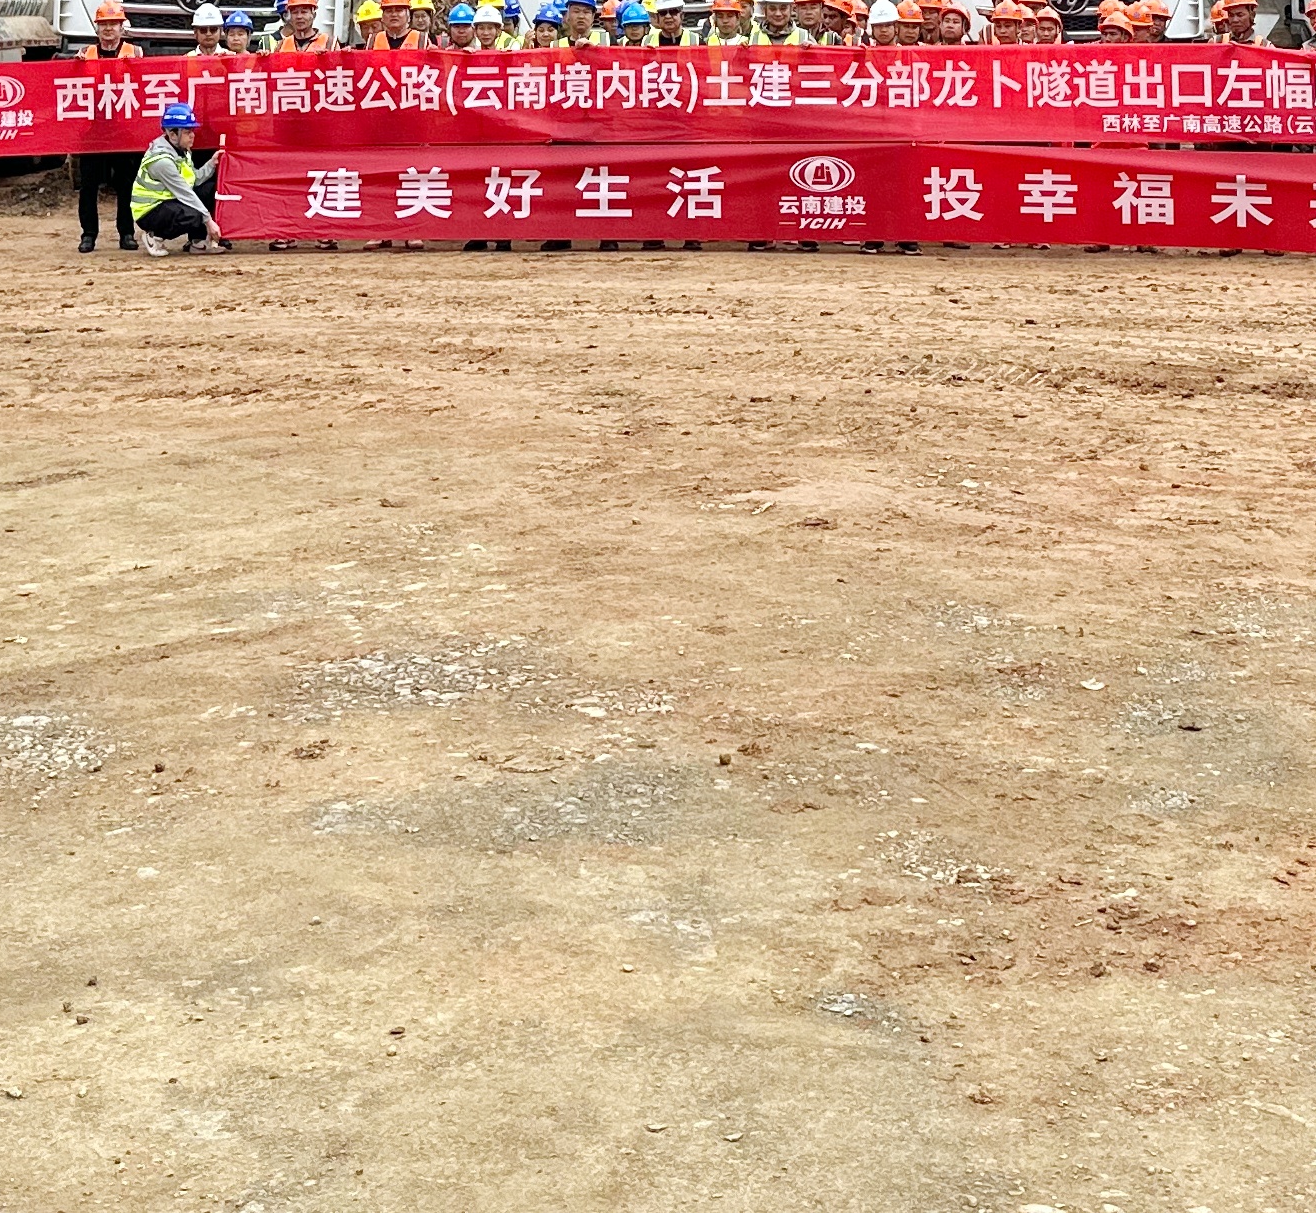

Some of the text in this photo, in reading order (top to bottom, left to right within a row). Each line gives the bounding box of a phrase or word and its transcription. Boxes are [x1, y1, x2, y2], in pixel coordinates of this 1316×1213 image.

[304, 166, 725, 219] 建美好生活
[778, 195, 867, 215] 云南建投
[798, 217, 847, 230] YCIH
